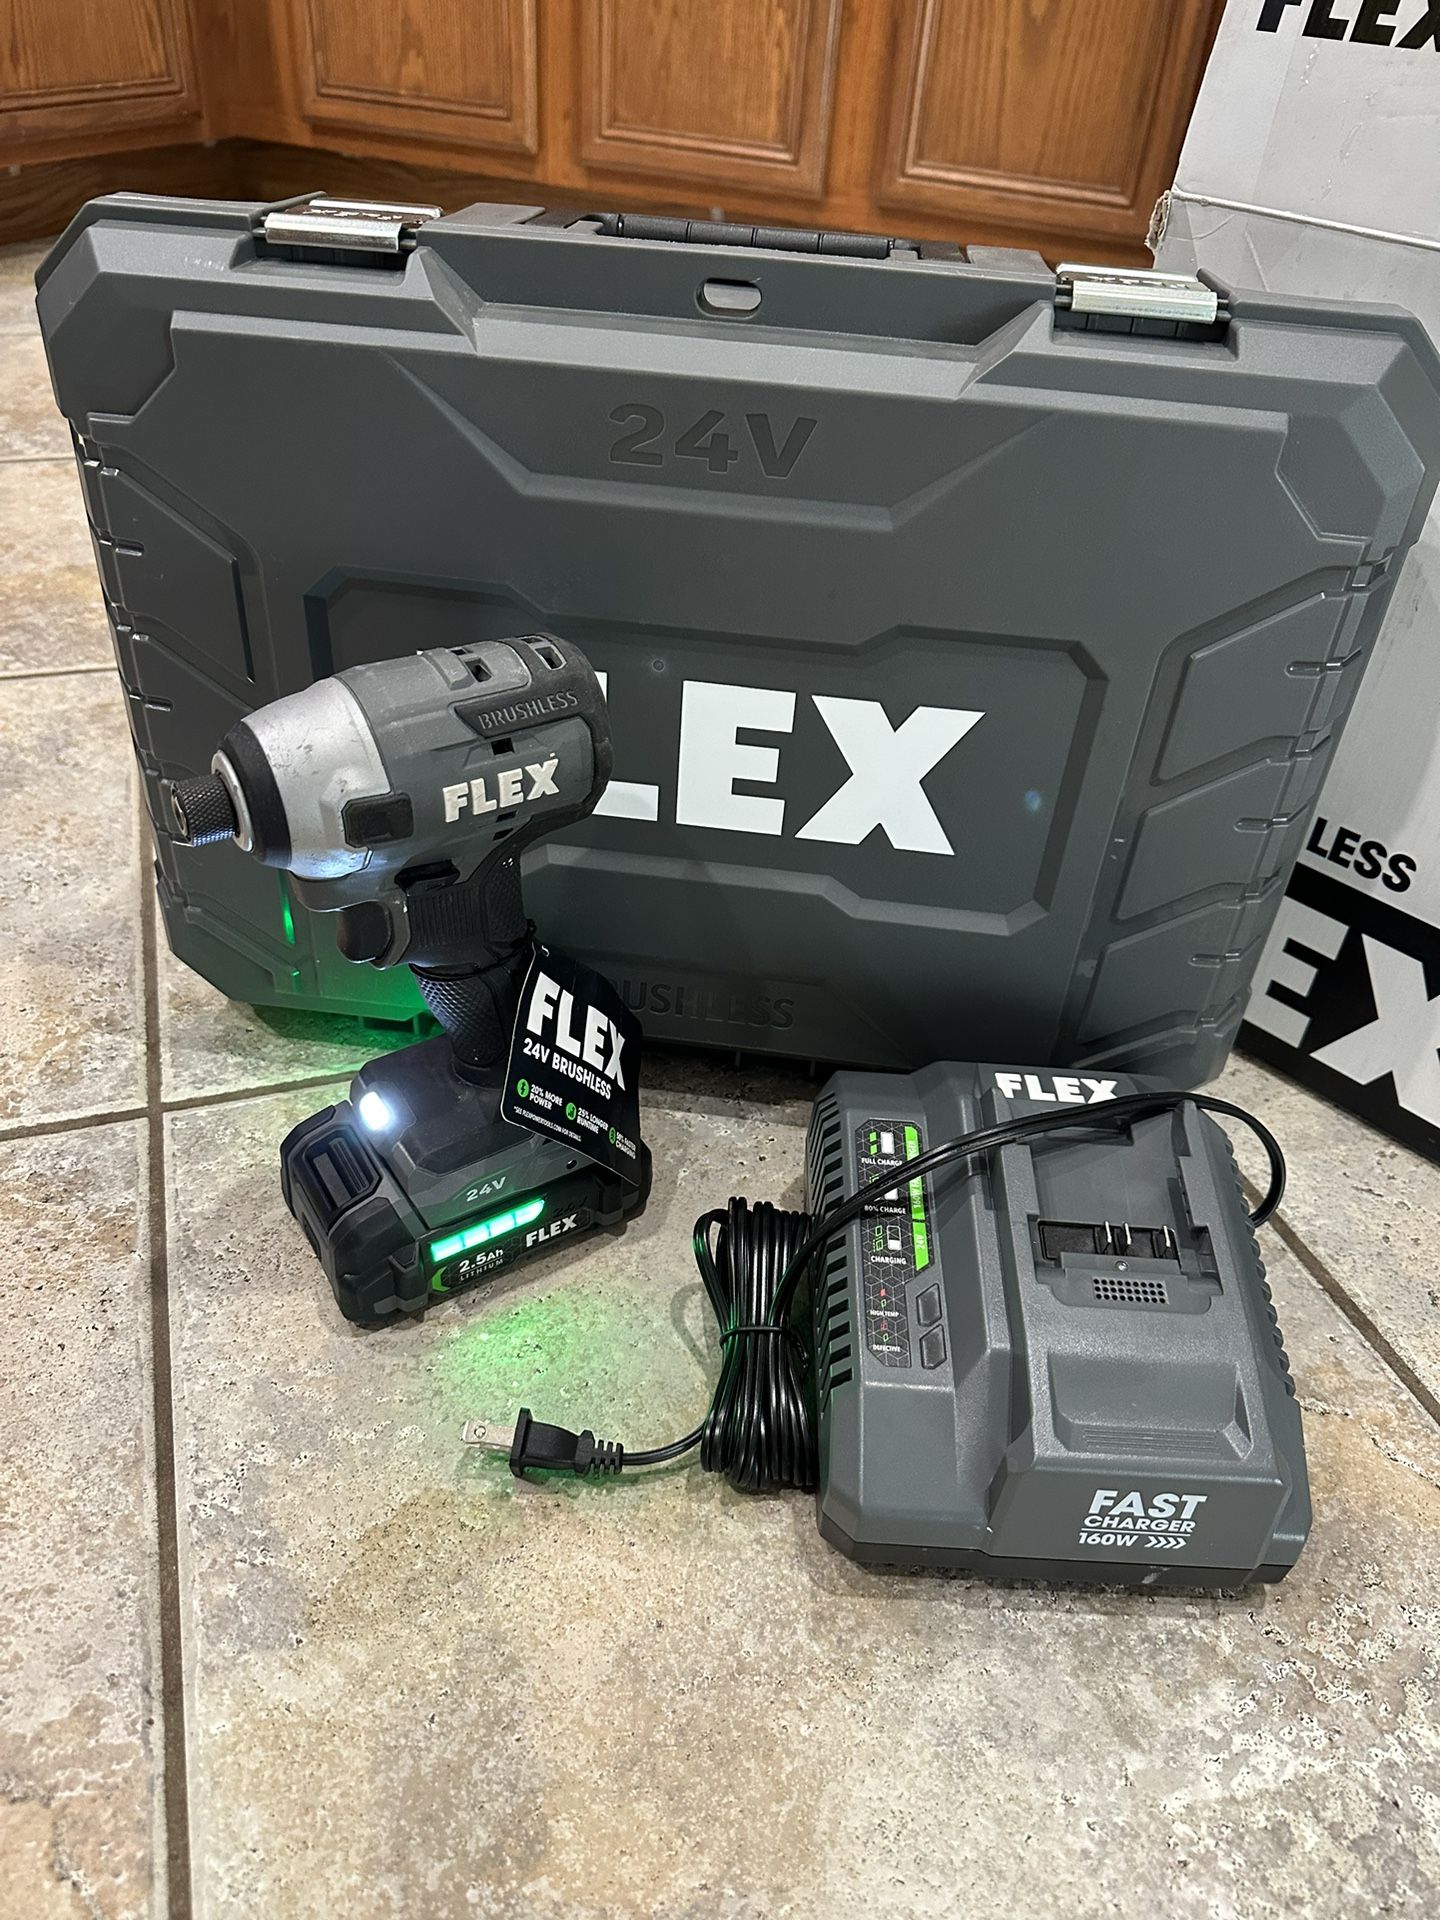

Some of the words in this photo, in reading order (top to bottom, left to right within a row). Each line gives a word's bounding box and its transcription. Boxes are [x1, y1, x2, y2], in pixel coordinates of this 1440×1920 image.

[609, 402, 818, 480] 24V
[477, 689, 579, 730] BRUSHLESS
[592, 671, 986, 856] EX
[442, 757, 561, 823] FLEX
[1306, 817, 1418, 893] LESS
[615, 979, 795, 1031] USHLESS
[1244, 896, 1440, 1130] EX
[527, 971, 626, 1091] FLEX
[523, 1038, 550, 1065] 24V
[552, 1052, 611, 1100] BRUSHLESS
[531, 1084, 544, 1097] 20%
[545, 1090, 563, 1106] MORE
[994, 1072, 1118, 1104] FLEX
[529, 1093, 552, 1110] POWER
[577, 1116, 599, 1134] RUNTIME
[578, 1108, 589, 1120] 25%
[590, 1113, 609, 1131] LONGER
[861, 1157, 876, 1165] FULL
[467, 1176, 507, 1202] 24V
[864, 1204, 878, 1212] 80%
[880, 1206, 906, 1214] CHARGE
[526, 1214, 578, 1248] FLEX
[459, 1248, 504, 1273] 2.5Ah
[460, 1258, 505, 1281] LITHIUM
[870, 1255, 907, 1265] CHARGING
[872, 1345, 901, 1353] DEFECTIVE
[1089, 1489, 1207, 1520] FAST
[1083, 1514, 1196, 1534] CHARGER
[1078, 1532, 1139, 1548] 160W
